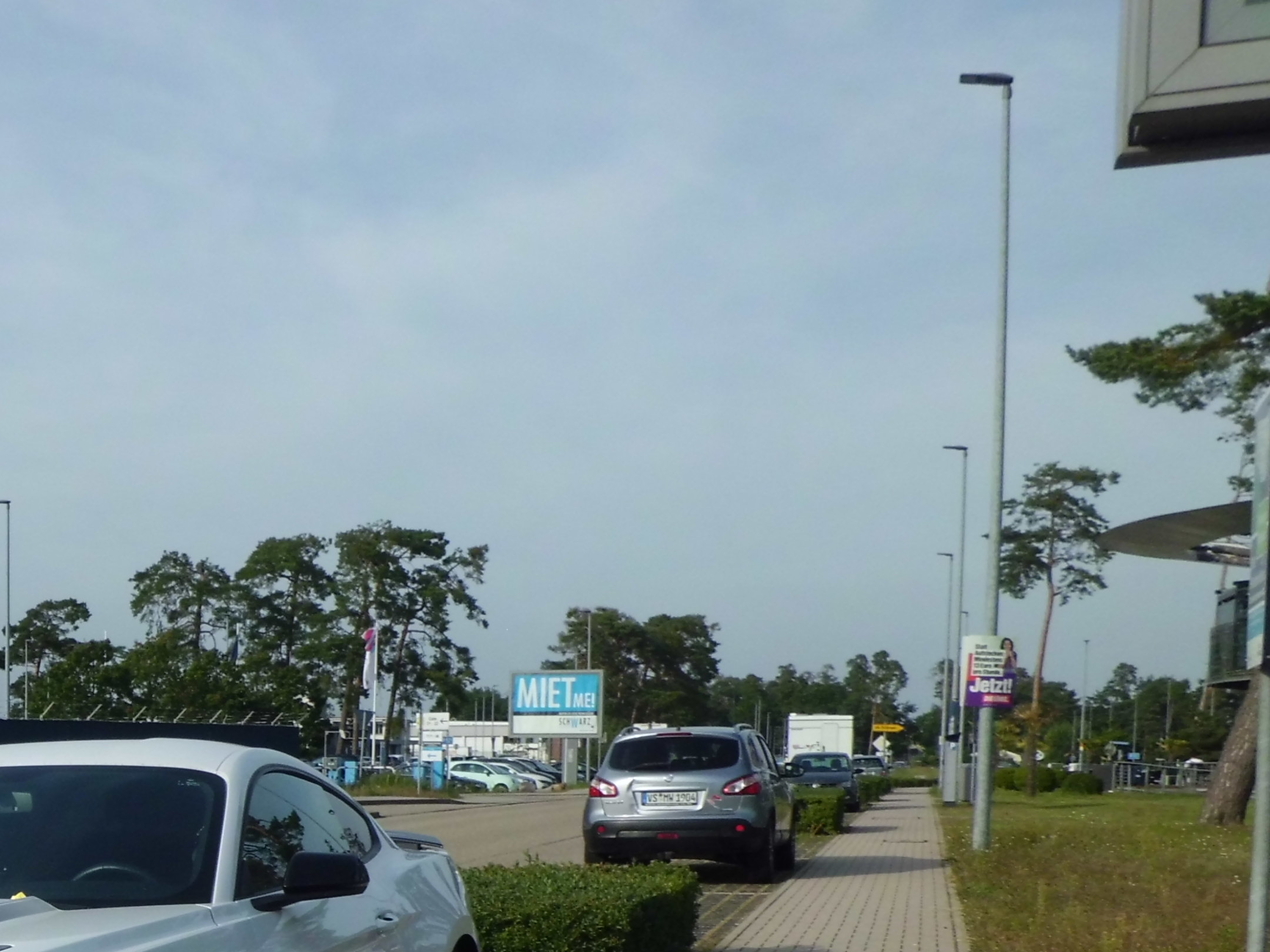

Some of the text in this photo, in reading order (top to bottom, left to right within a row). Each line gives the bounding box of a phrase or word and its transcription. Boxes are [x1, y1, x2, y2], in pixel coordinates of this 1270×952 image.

[517, 677, 595, 708] MIET ME!
[969, 677, 1013, 693] Jetzt!
